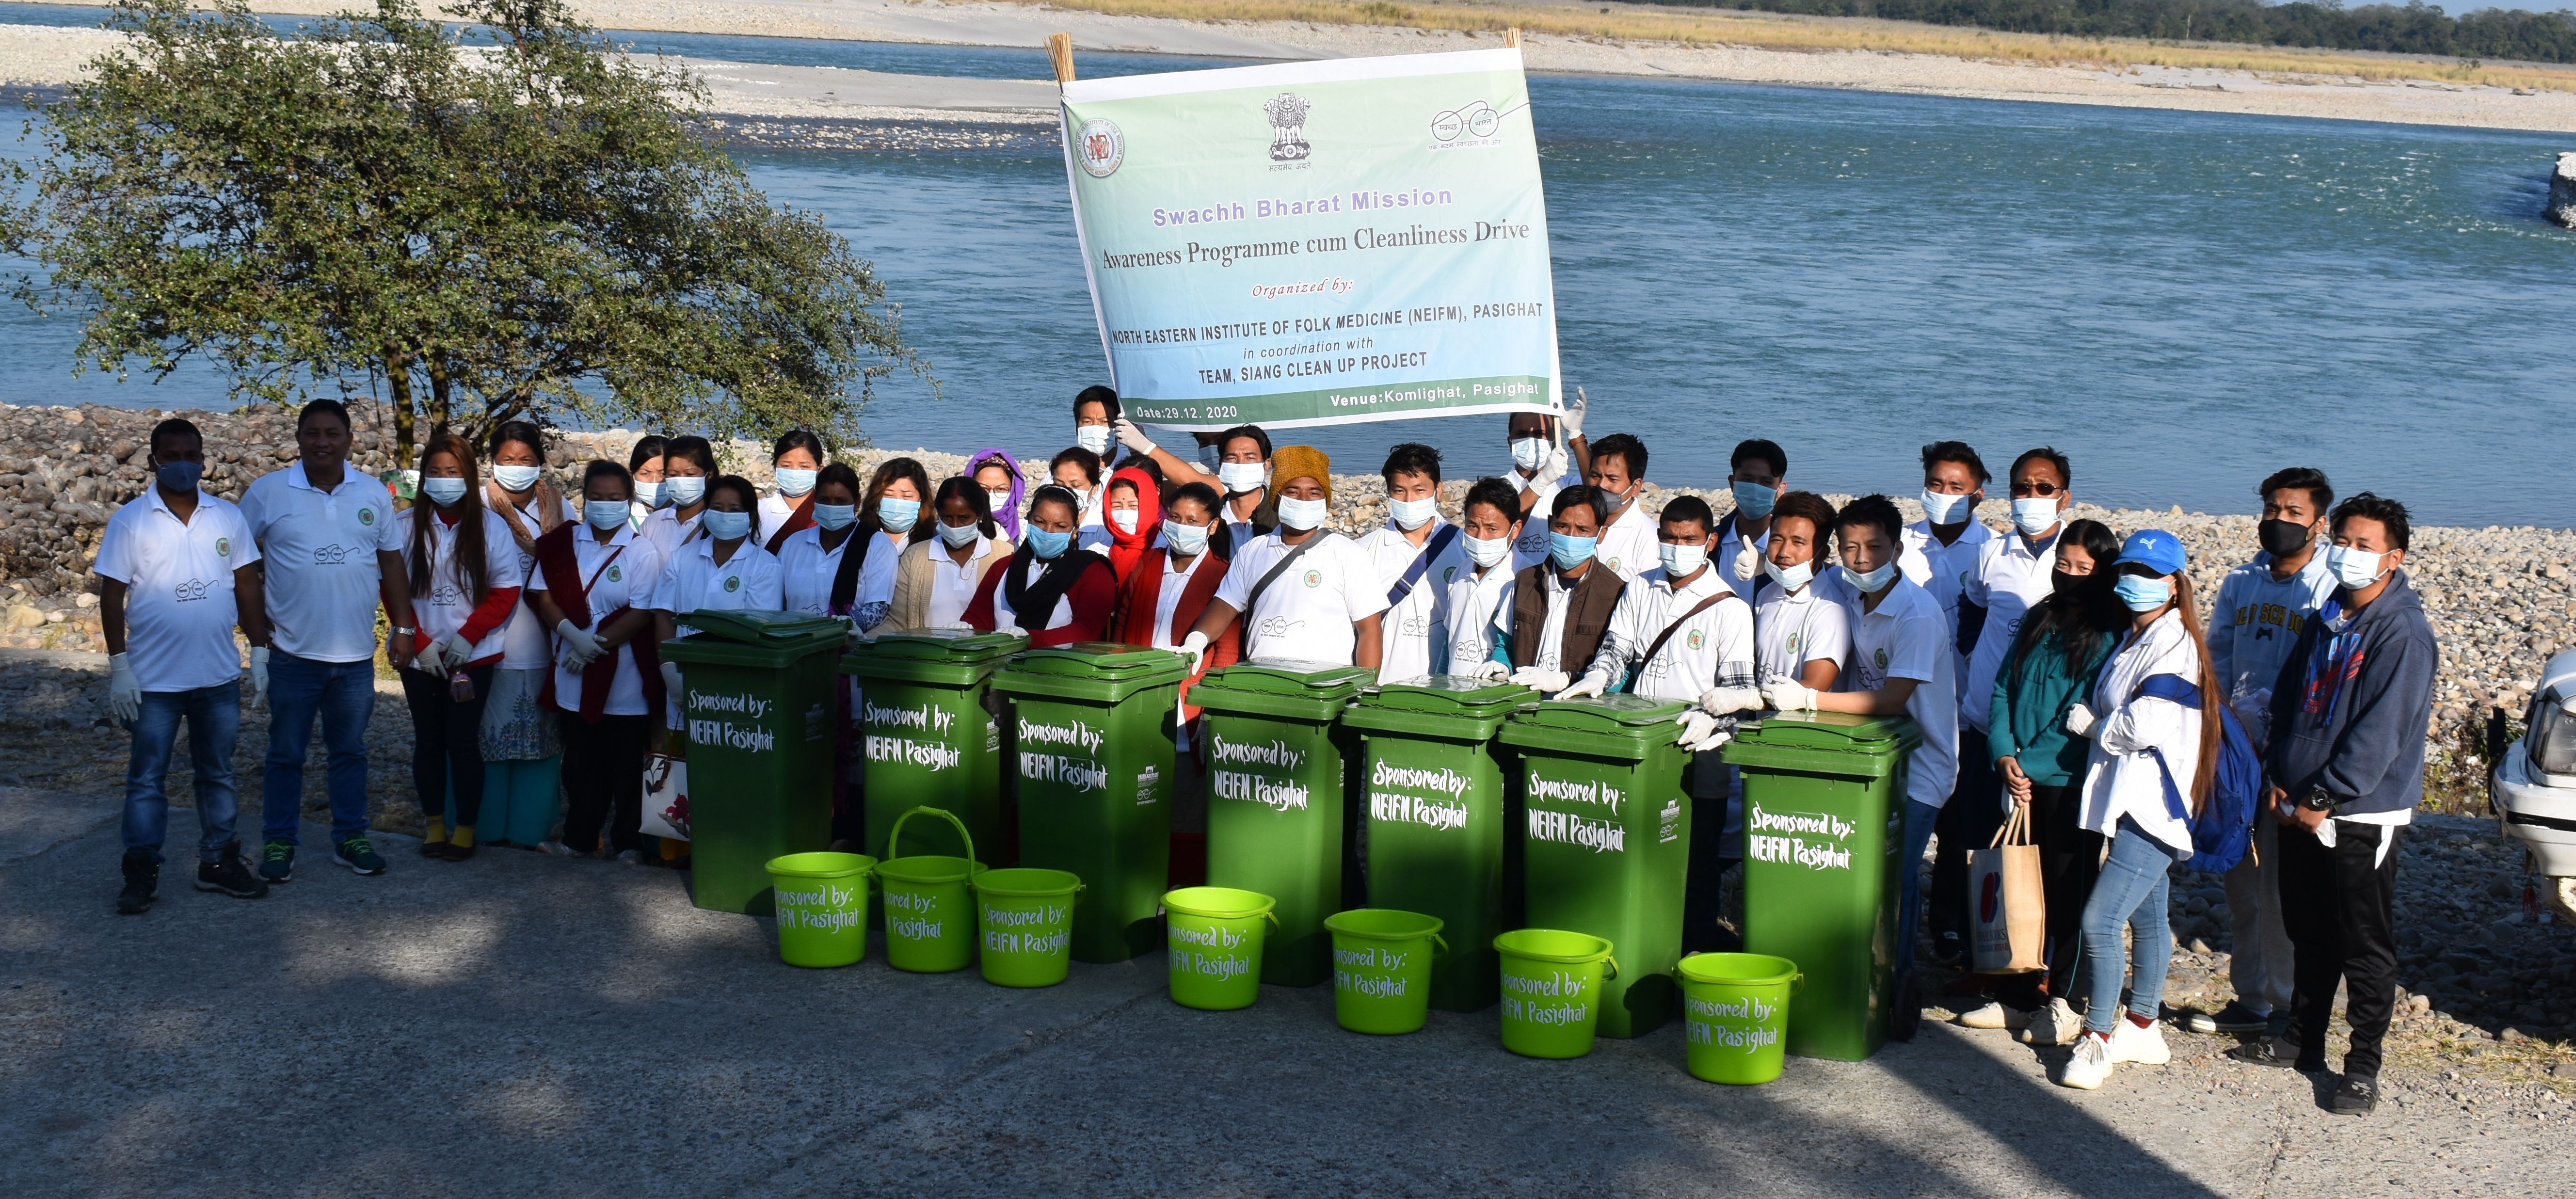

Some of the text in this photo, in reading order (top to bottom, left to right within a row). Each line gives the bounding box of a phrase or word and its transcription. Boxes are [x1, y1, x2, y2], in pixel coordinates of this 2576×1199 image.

[1109, 125, 1119, 135] FOLK
[1438, 124, 1457, 132] स्वच्छ
[1268, 161, 1312, 172] सत्यमेव जयते
[1153, 189, 1452, 226] Swachh Bharat Mission
[1103, 219, 1530, 269] Awareness Programme cum Cleanliness Drive
[1252, 278, 1354, 299] Organized by:
[1112, 303, 1542, 344] NORTH EASTERN INSTITUTE OF FOLK MEDICINE (NEIFM), PASIGHAT
[1243, 337, 1374, 359] in coordination with
[1199, 352, 1427, 385] TEAM, SIANG CLEAN UP PROJECT
[1473, 382, 1539, 396] Pasighat
[1206, 405, 1237, 419] 2020
[688, 687, 773, 719] Sponsored by:
[865, 699, 928, 732] Sponsored
[934, 704, 955, 737] by:
[689, 719, 775, 752] NEIFM Pasighat
[1019, 716, 1077, 747] Sponsored
[1080, 721, 1104, 757] by:
[1213, 733, 1278, 765] Sponsored
[866, 735, 961, 771] NEIFM Pasighat
[1020, 751, 1108, 793] NEIFM Pasighat
[1373, 757, 1472, 801] Sponsored by:
[1215, 770, 1309, 812] NEIFM Pasighat
[1529, 769, 1596, 804] Sponsored
[1371, 792, 1468, 831] NEIFM Pasighat
[1750, 801, 1827, 834] Sponsored
[1831, 815, 1856, 840] by:
[1529, 808, 1626, 853] NEIFM Pasighat
[1750, 835, 1852, 870] NEIFM Pasighat
[832, 885, 854, 907] by:
[914, 894, 936, 913] by:
[801, 908, 859, 934] Pasighat
[893, 917, 942, 940] Pasighat
[985, 903, 1067, 927] Sponsored by:
[985, 929, 1071, 956] NEIFM Pasighat
[1222, 927, 1247, 949] by:
[1195, 953, 1249, 981] Pasighat
[1382, 949, 1408, 971] by:
[1355, 974, 1408, 998] Pasighat
[1565, 972, 1587, 997] by:
[1528, 1001, 1588, 1026] Pasighat
[1754, 996, 1778, 1022] by:
[1715, 1025, 1778, 1054] Pasighat
